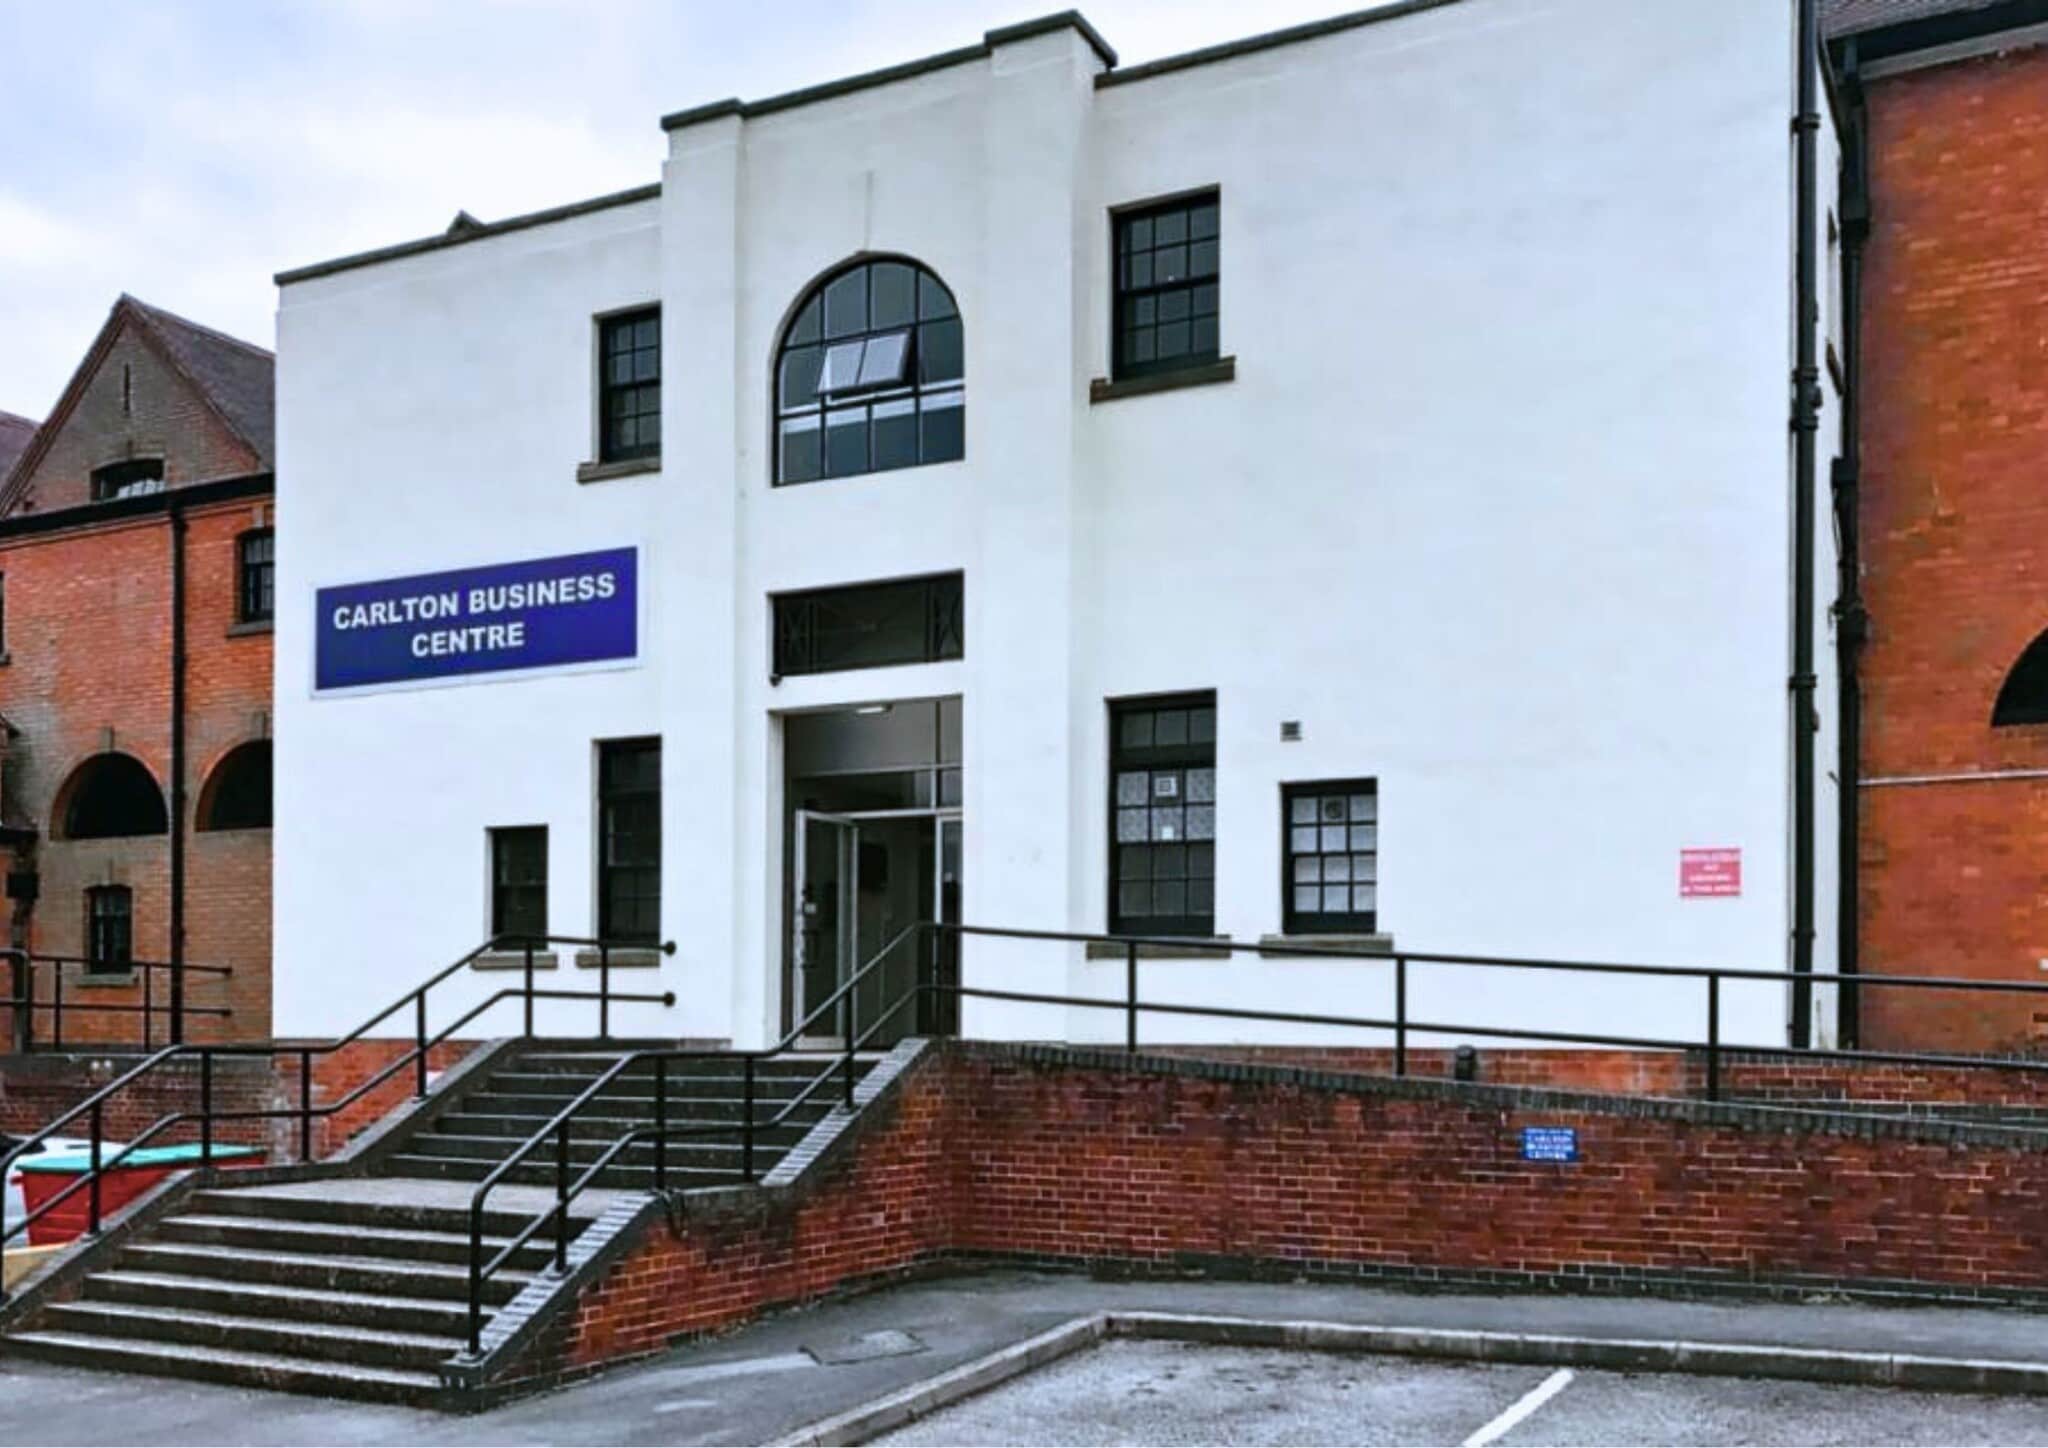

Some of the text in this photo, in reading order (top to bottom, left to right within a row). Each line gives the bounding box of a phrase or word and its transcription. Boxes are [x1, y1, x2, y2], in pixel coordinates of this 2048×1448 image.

[333, 573, 615, 629] CARLTON BUSINESS
[412, 622, 524, 657] CENTRE
